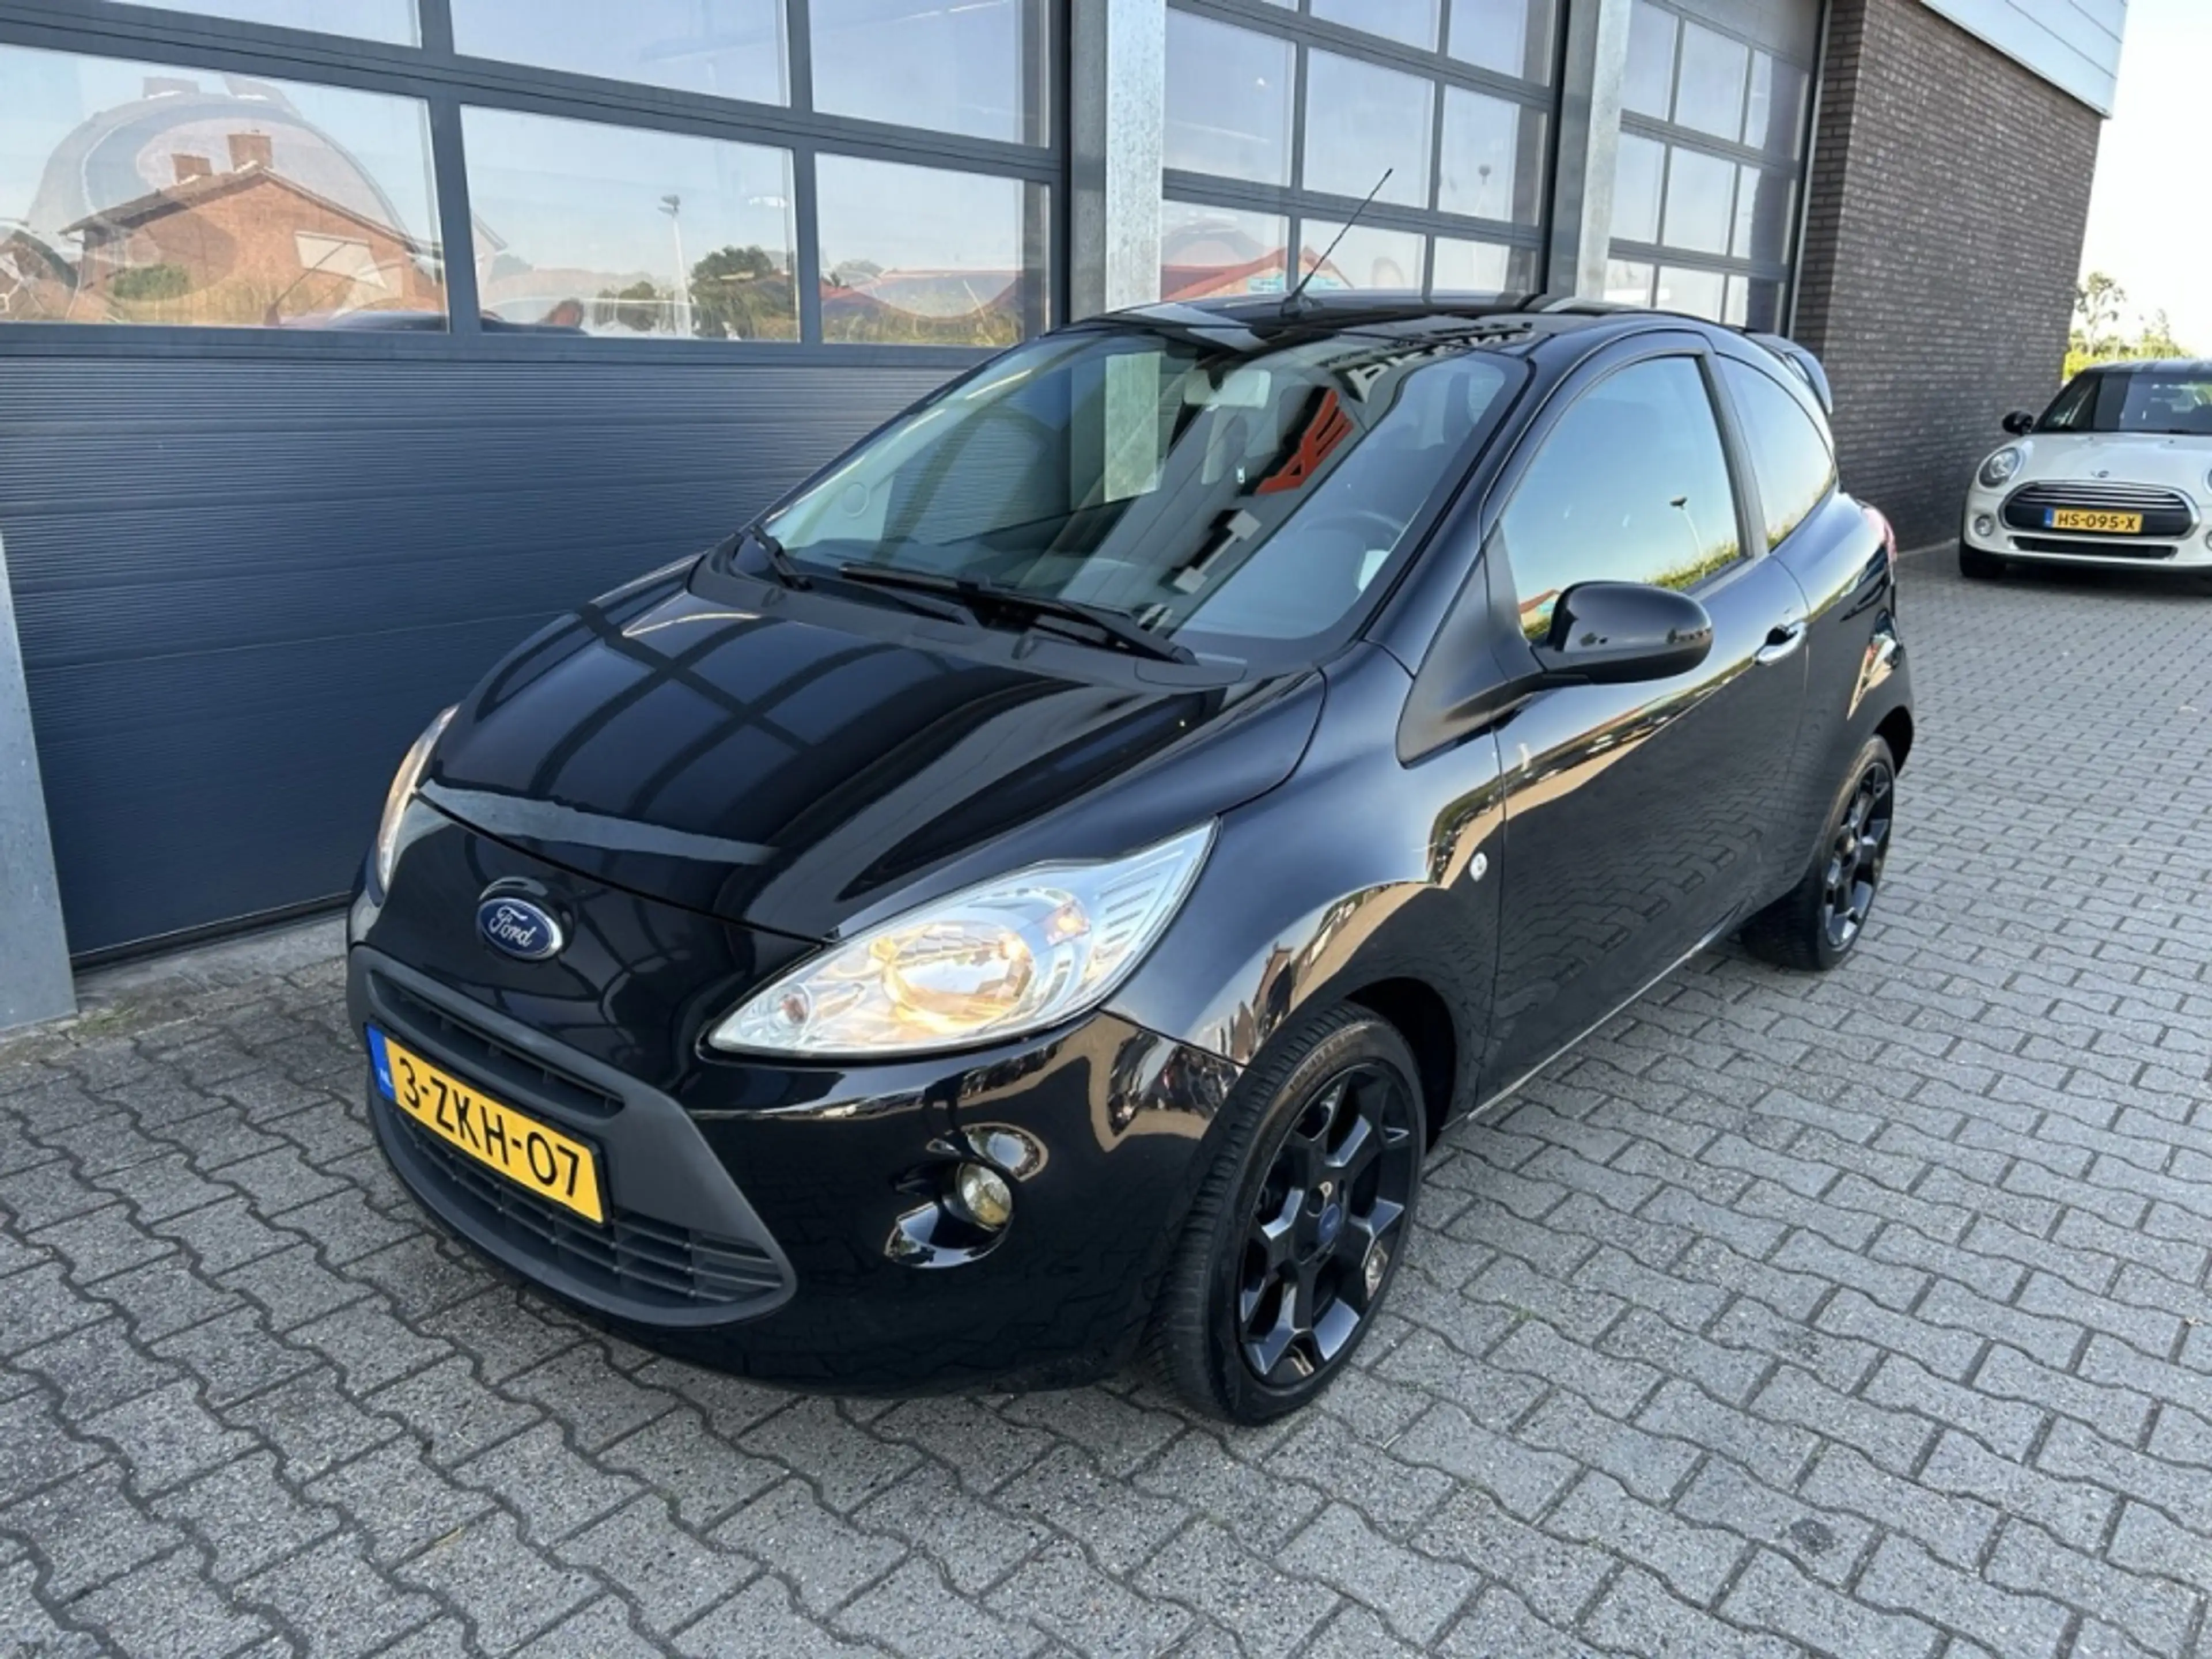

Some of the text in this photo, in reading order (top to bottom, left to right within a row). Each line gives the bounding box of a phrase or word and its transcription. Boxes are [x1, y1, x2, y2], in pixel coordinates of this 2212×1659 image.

[2058, 514, 2135, 530] HS-095-X
[488, 906, 536, 947] Ford
[400, 1058, 579, 1197] 3-ZKH-07
